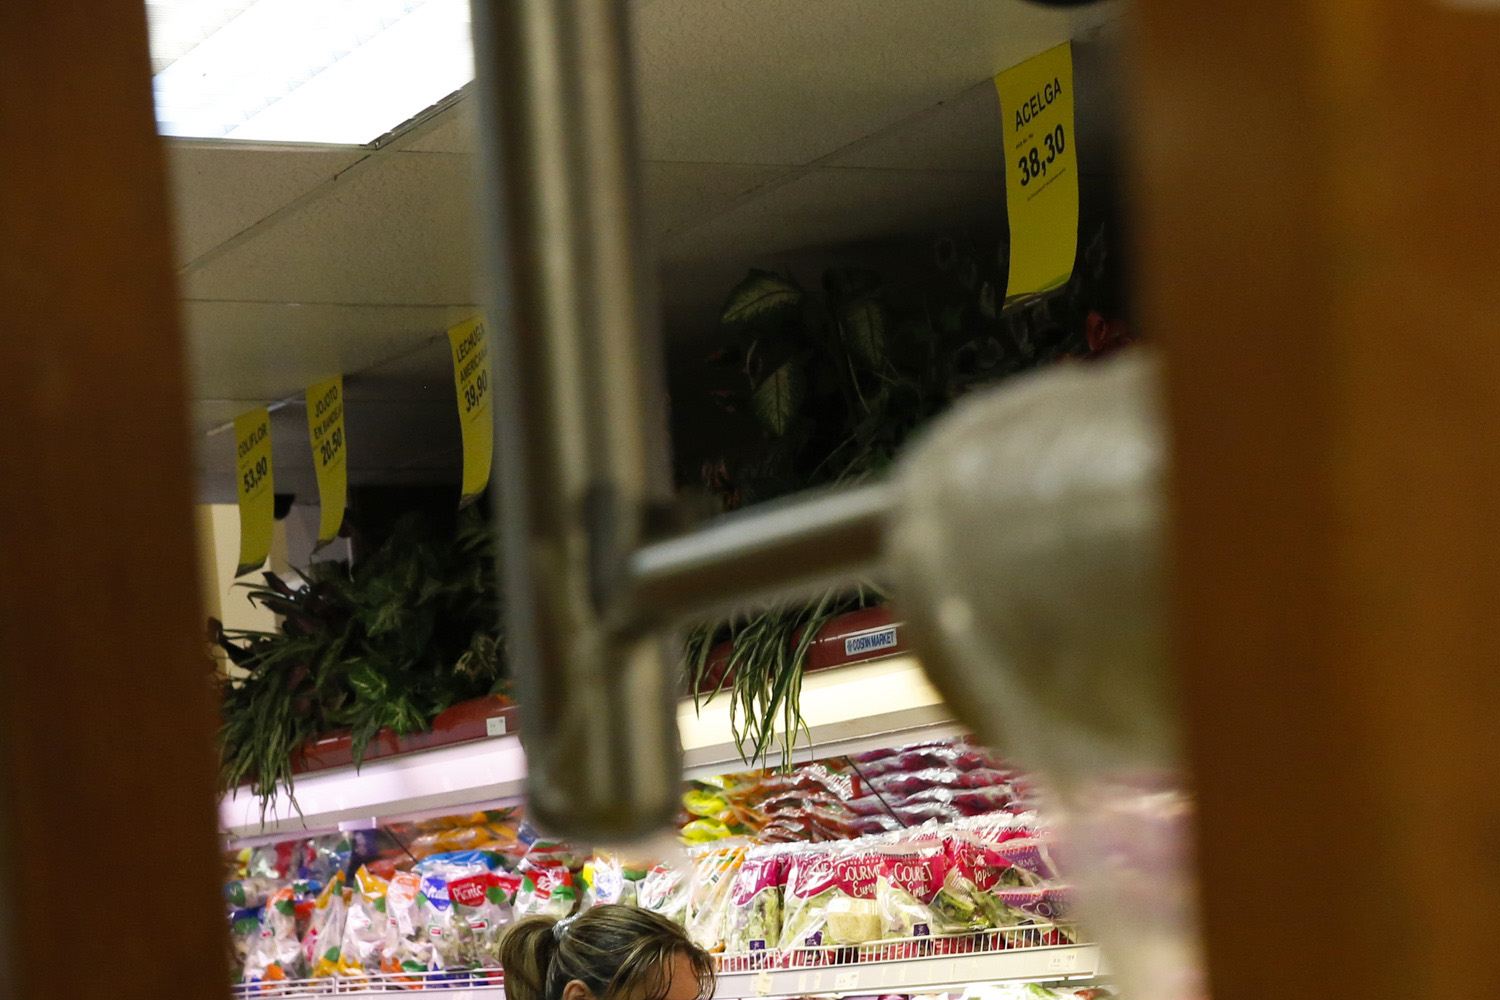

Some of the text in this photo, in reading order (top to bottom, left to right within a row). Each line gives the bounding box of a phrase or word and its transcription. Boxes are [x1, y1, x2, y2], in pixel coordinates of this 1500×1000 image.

[1015, 77, 1062, 132] ACELGA
[1018, 123, 1065, 186] 38,30
[464, 368, 488, 413] 39,90
[320, 427, 342, 466] 20,50
[243, 456, 267, 493] 53,90
[870, 631, 894, 647] MARKET
